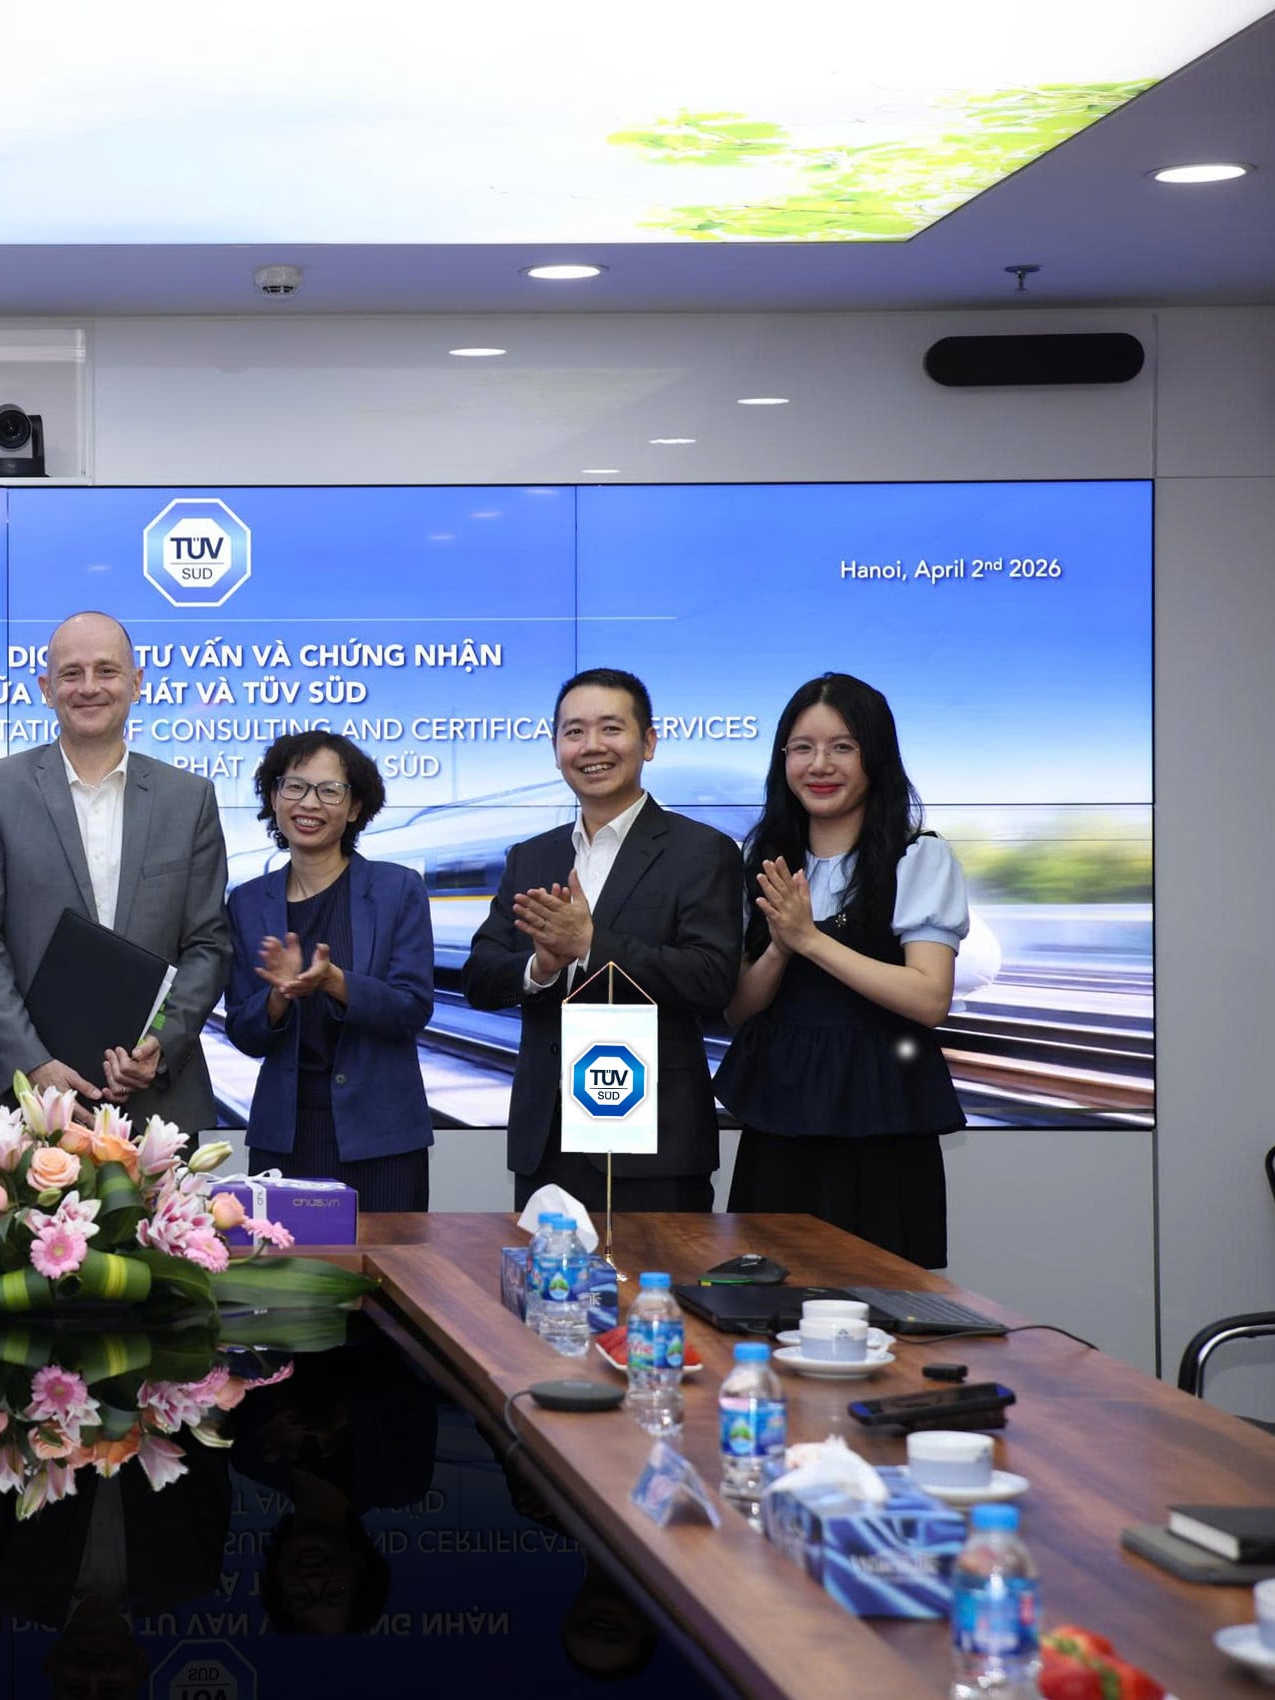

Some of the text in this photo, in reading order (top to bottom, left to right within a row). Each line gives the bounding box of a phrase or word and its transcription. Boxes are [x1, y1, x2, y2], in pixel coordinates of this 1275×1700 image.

[170, 537, 224, 560] TÜV
[840, 557, 1062, 584] Hanoi, April 2nd 2026
[8, 645, 49, 675] DỊC
[134, 643, 174, 668] TƯ
[180, 636, 244, 668] VẤN
[252, 639, 292, 668] VÀ
[299, 637, 406, 668] CHỨNG
[415, 638, 502, 673] NHẬN
[134, 676, 189, 705] HÁT
[196, 676, 235, 705] VÀ
[243, 675, 301, 705] TÜV
[309, 675, 367, 705] SÜD
[341, 718, 404, 741] AND
[652, 715, 759, 739] ERVICES
[384, 754, 441, 779] SÜD
[589, 1069, 628, 1086] TÜV
